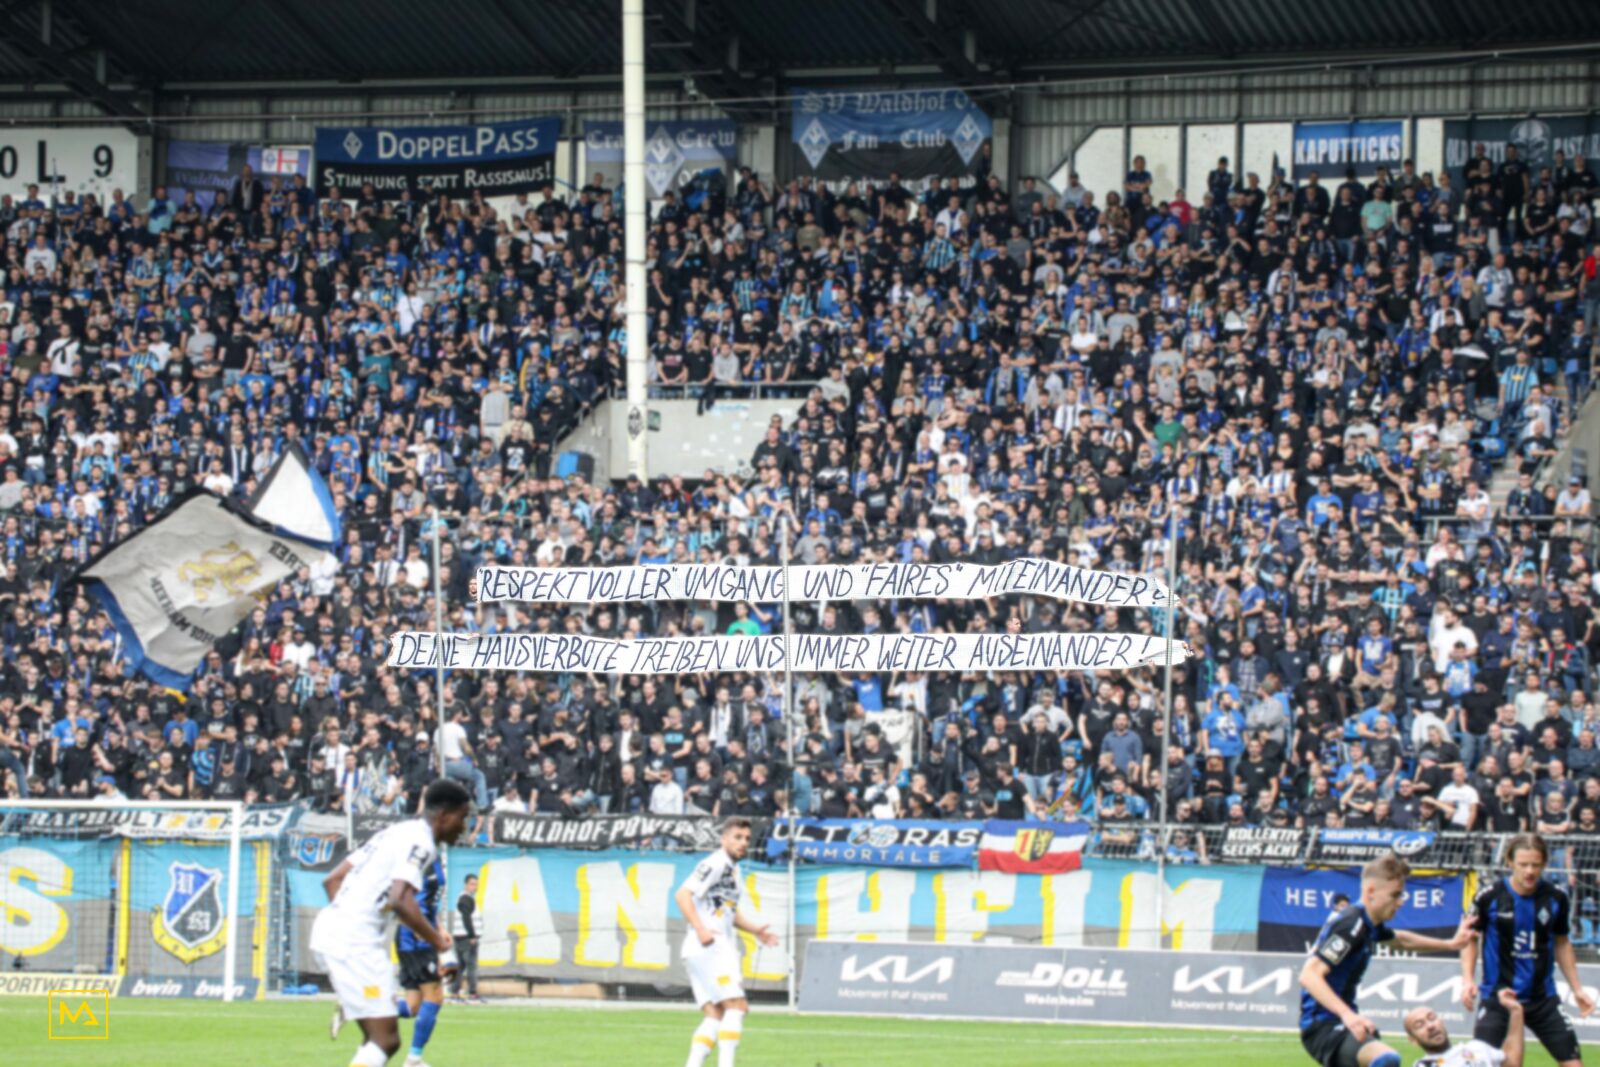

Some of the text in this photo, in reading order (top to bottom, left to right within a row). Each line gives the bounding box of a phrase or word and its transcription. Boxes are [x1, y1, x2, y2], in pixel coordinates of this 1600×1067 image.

[1295, 135, 1400, 164] KAPUTTICKS
[685, 566, 784, 600] UMGANG
[804, 568, 853, 599] UND
[396, 633, 468, 667] DEINE
[471, 634, 629, 671] HAUSVERBOTE
[631, 639, 729, 672] TREIBEN
[735, 636, 785, 671] UNS
[795, 634, 870, 670] IMMER
[876, 634, 957, 670] WEITER
[1286, 887, 1335, 908] HEY
[131, 979, 182, 996] bwin
[194, 980, 245, 997] bwn
[838, 987, 888, 999] Movement
[890, 989, 910, 1000] that
[1024, 993, 1095, 1006] Weinheim
[1171, 998, 1224, 1011] Movement
[1226, 1000, 1247, 1013] that
